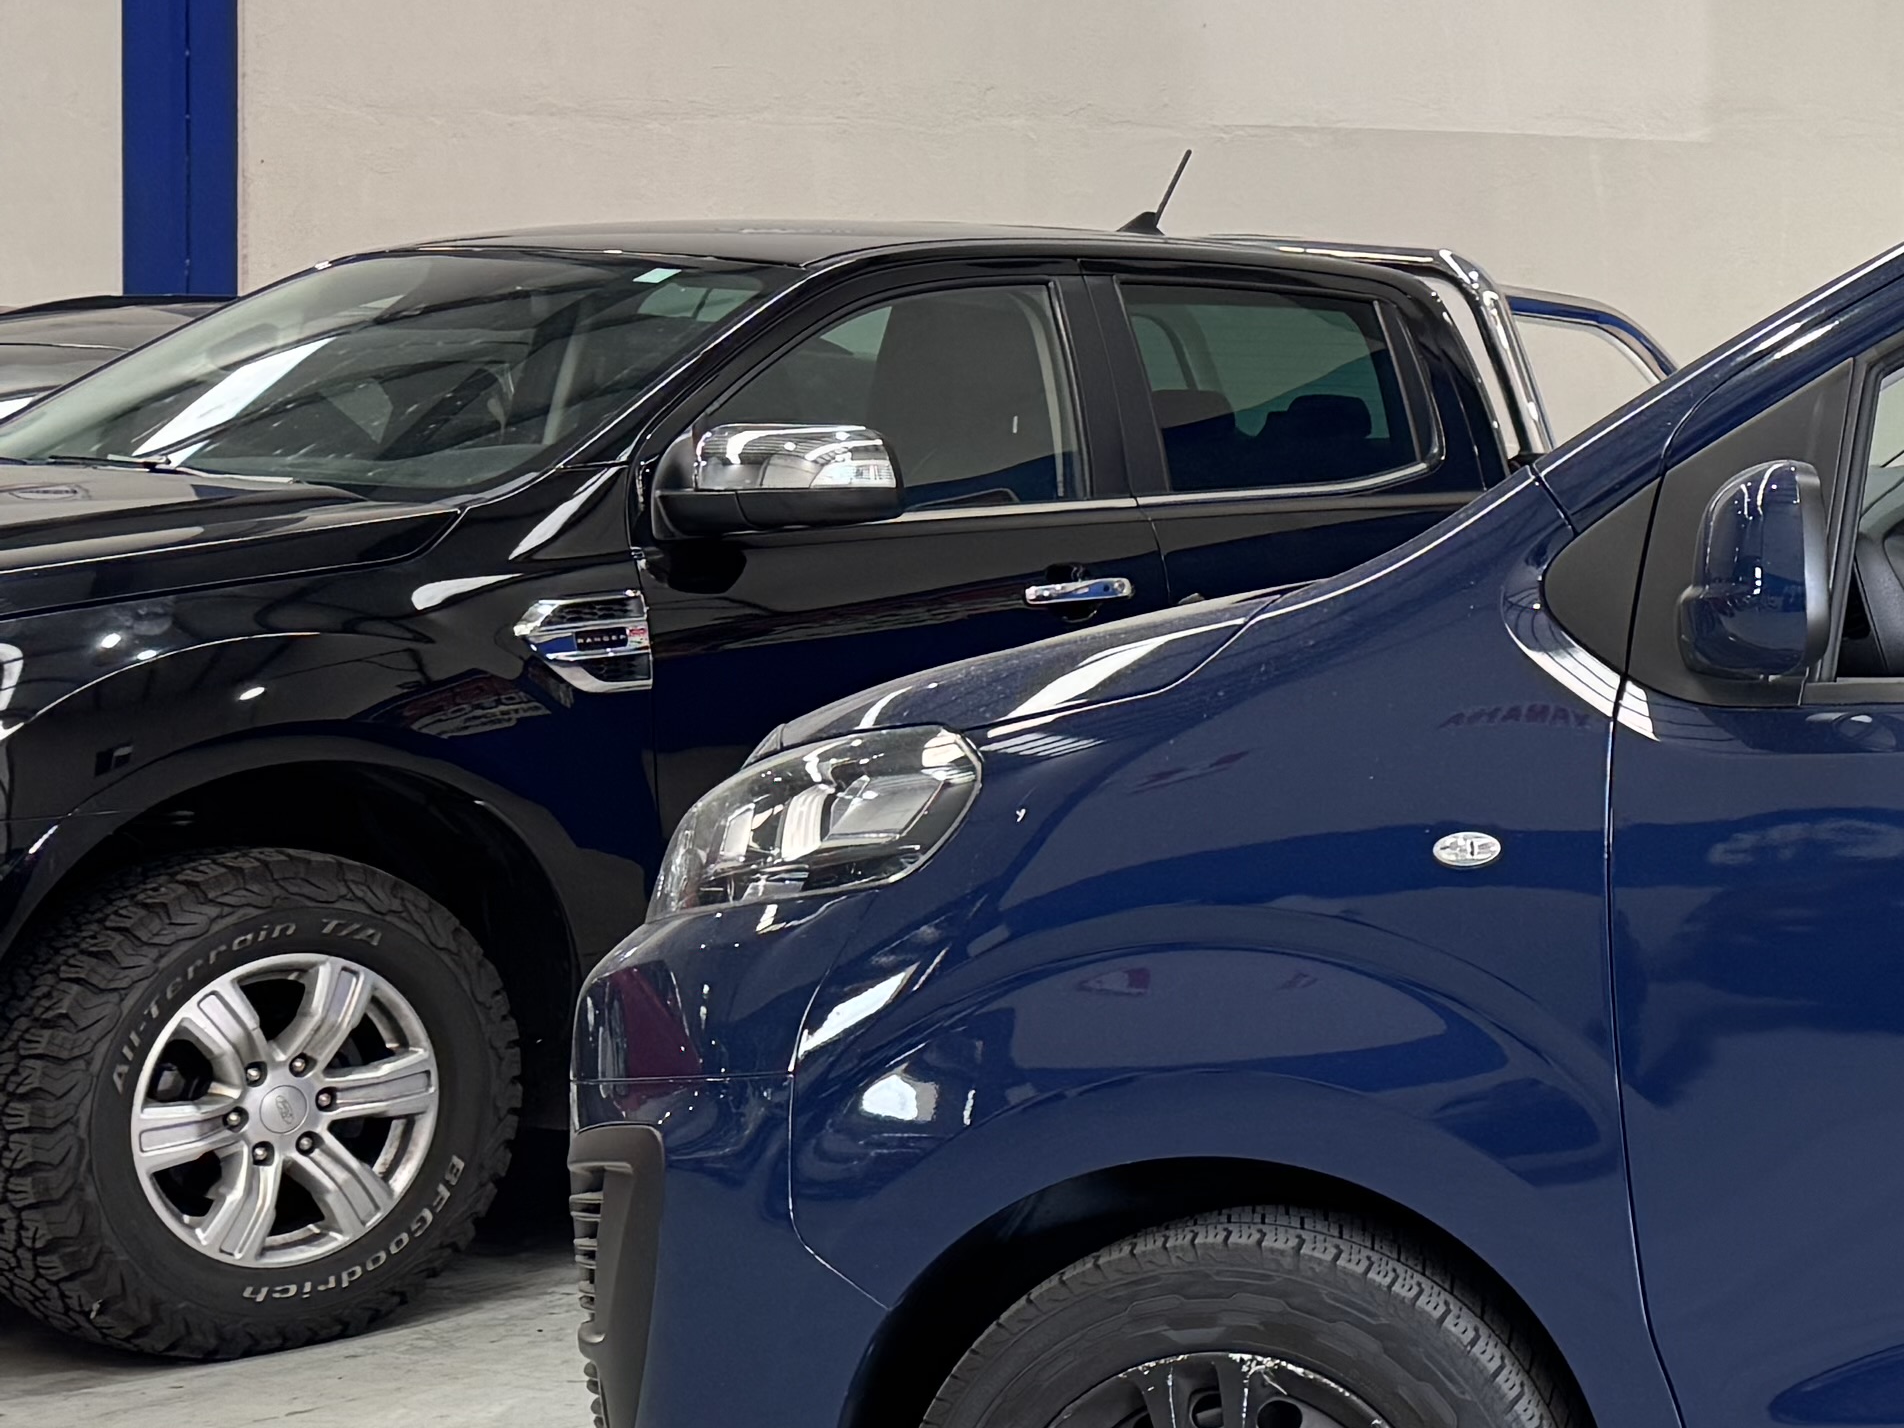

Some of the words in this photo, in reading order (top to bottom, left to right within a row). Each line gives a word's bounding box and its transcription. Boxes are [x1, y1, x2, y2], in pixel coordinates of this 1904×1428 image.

[112, 922, 297, 1094] All-Terrain
[321, 918, 383, 947] T/A
[242, 1154, 465, 1303] BFGoodrich
